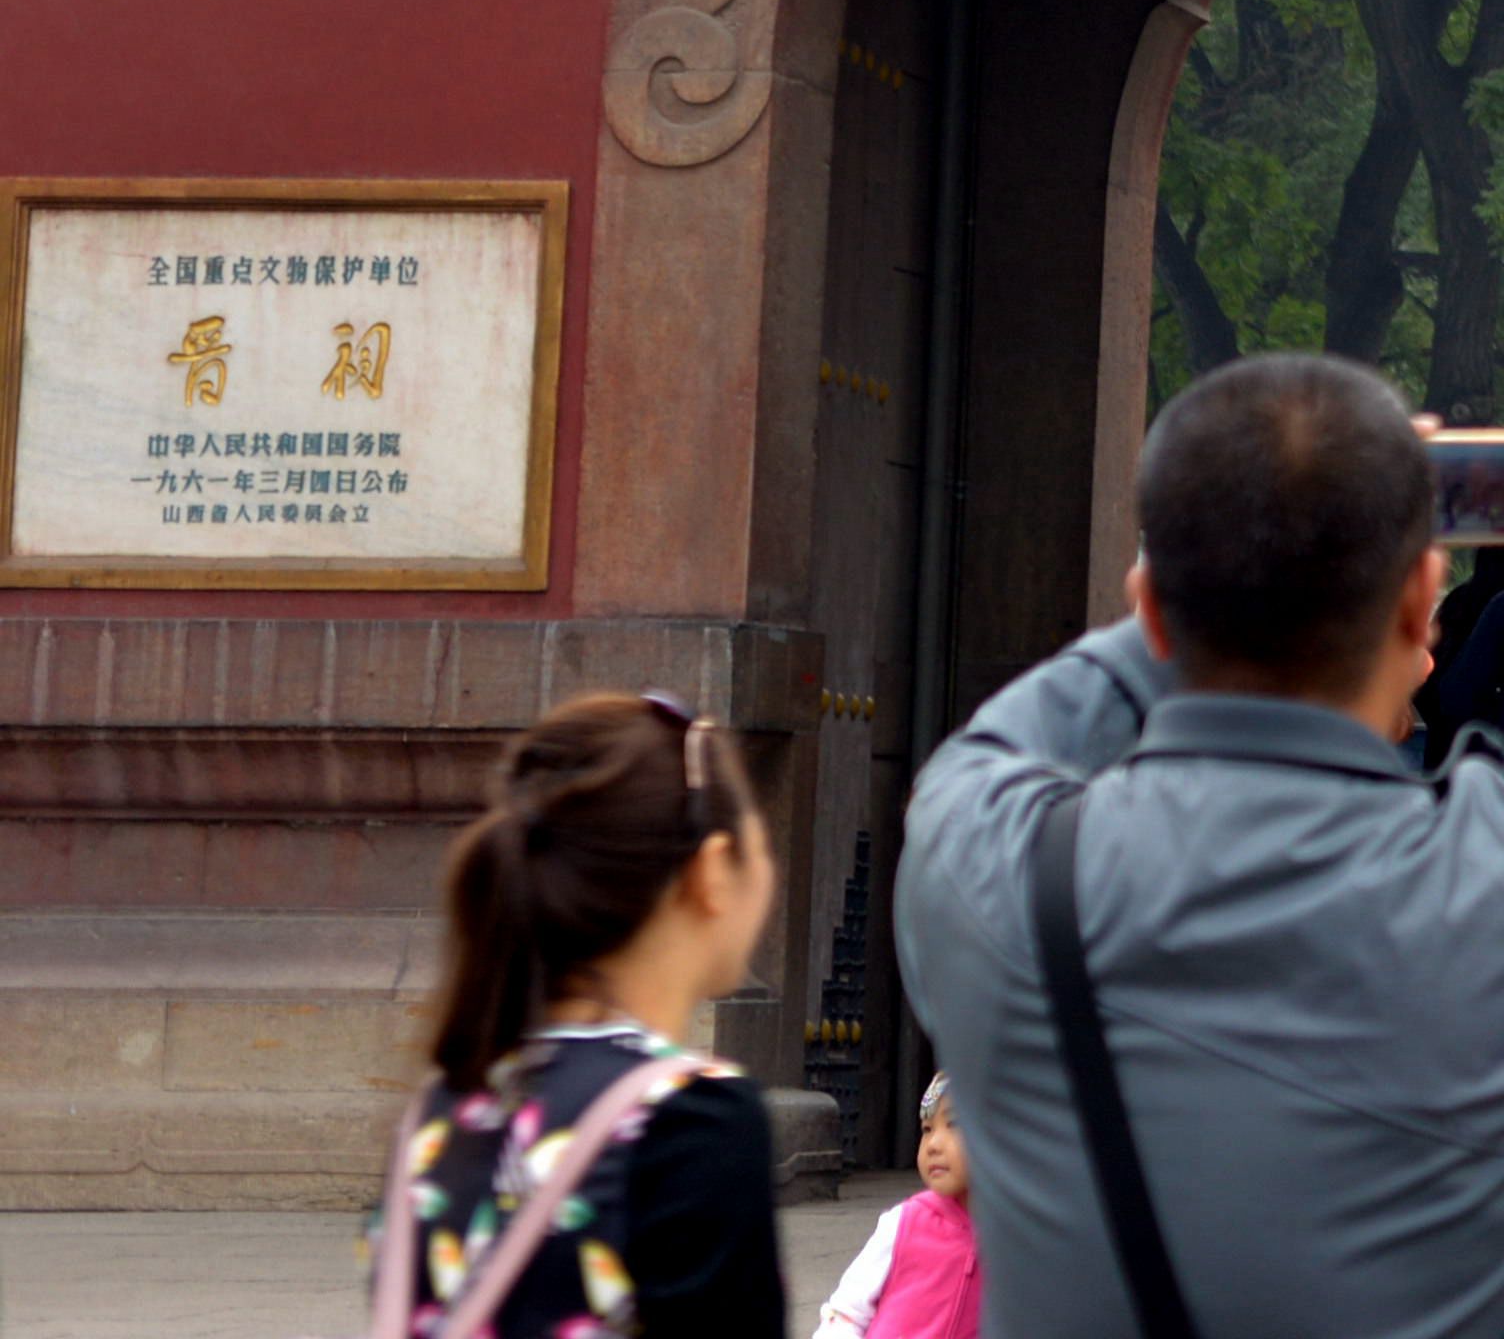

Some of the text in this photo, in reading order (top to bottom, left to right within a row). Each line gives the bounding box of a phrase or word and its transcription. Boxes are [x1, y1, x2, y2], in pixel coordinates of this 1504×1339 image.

[147, 255, 419, 286] 全国重点文物保护单位
[147, 432, 402, 457] 中华人民共和国国务院
[130, 469, 409, 494] 一九六一年三月四日公布
[162, 503, 370, 524] 山西省人民委员会立
